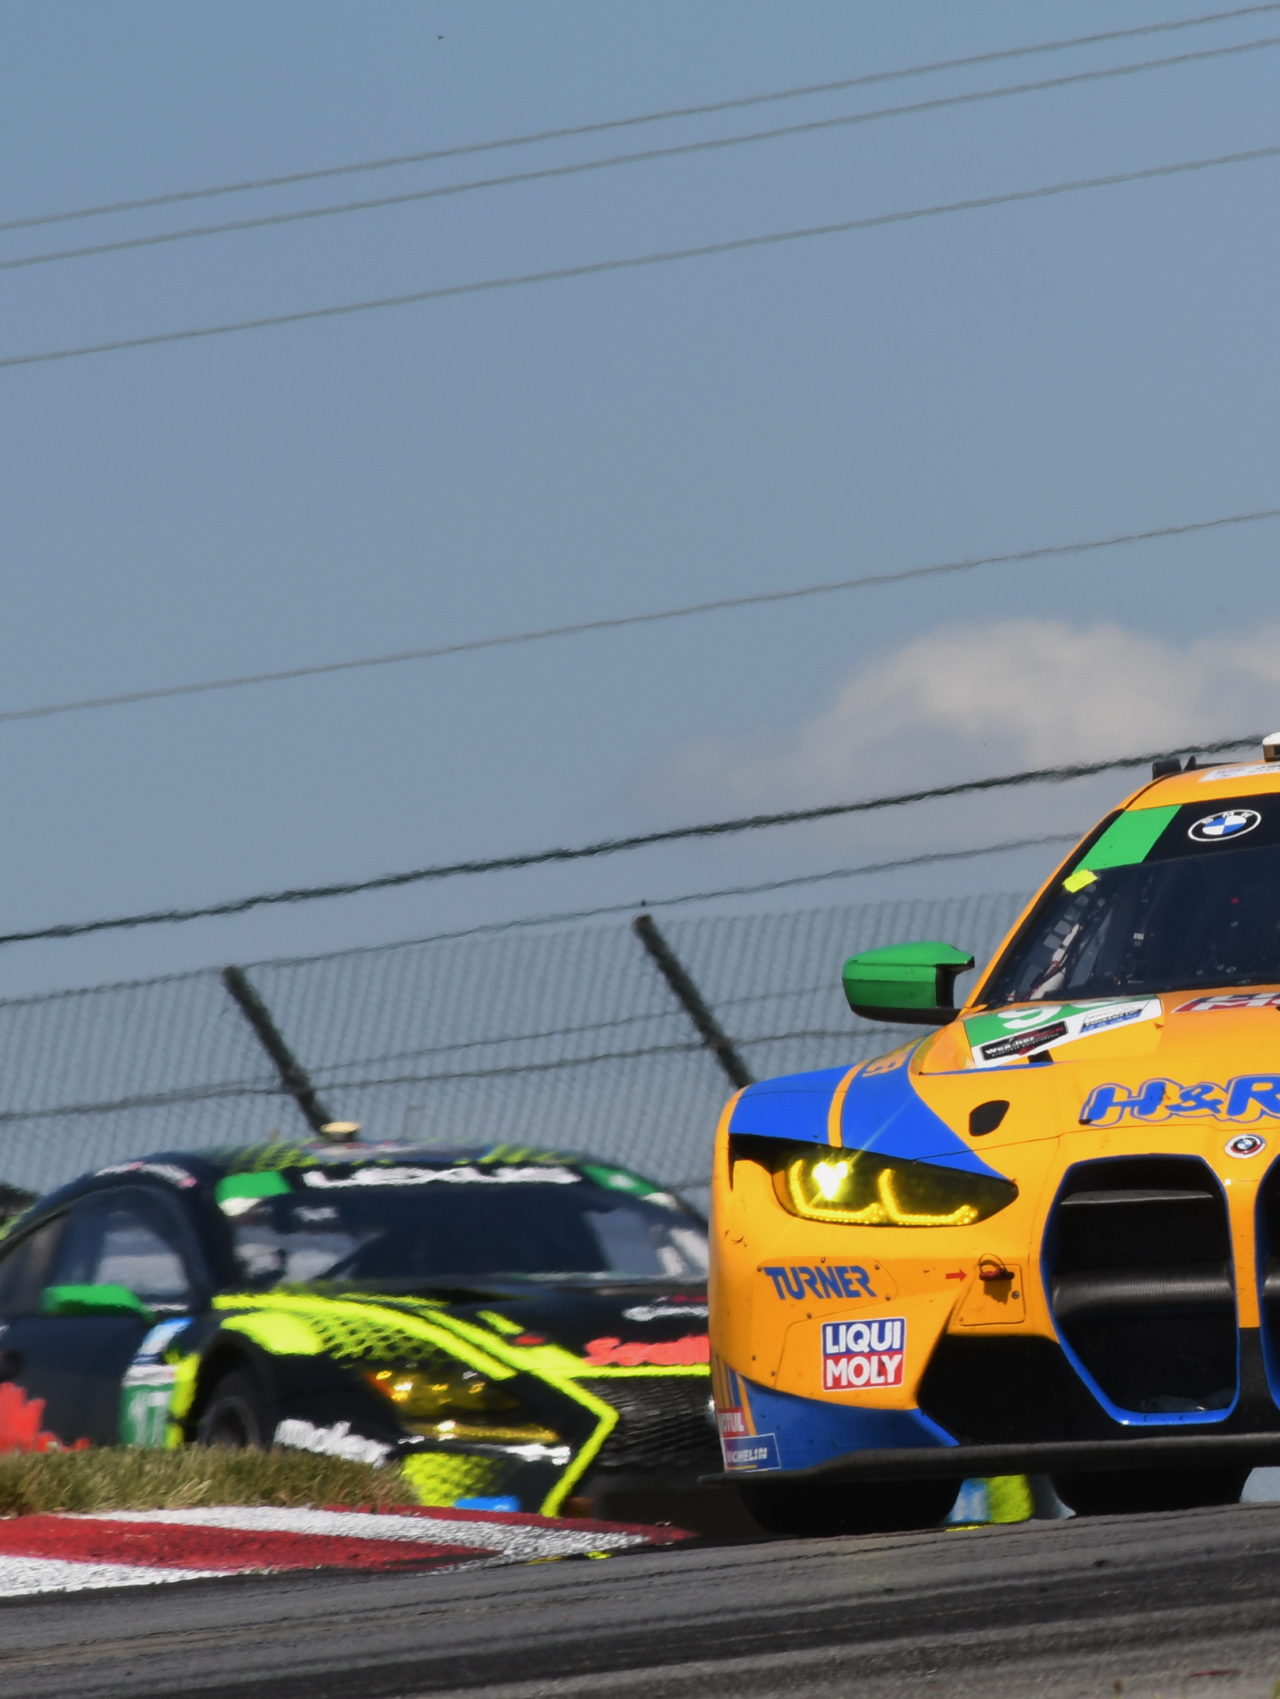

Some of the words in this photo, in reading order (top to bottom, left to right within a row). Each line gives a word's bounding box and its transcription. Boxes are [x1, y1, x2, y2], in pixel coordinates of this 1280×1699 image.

[765, 1266, 877, 1300] TURNER
[825, 1321, 901, 1353] LIQUI
[827, 1355, 902, 1386] MOLY
